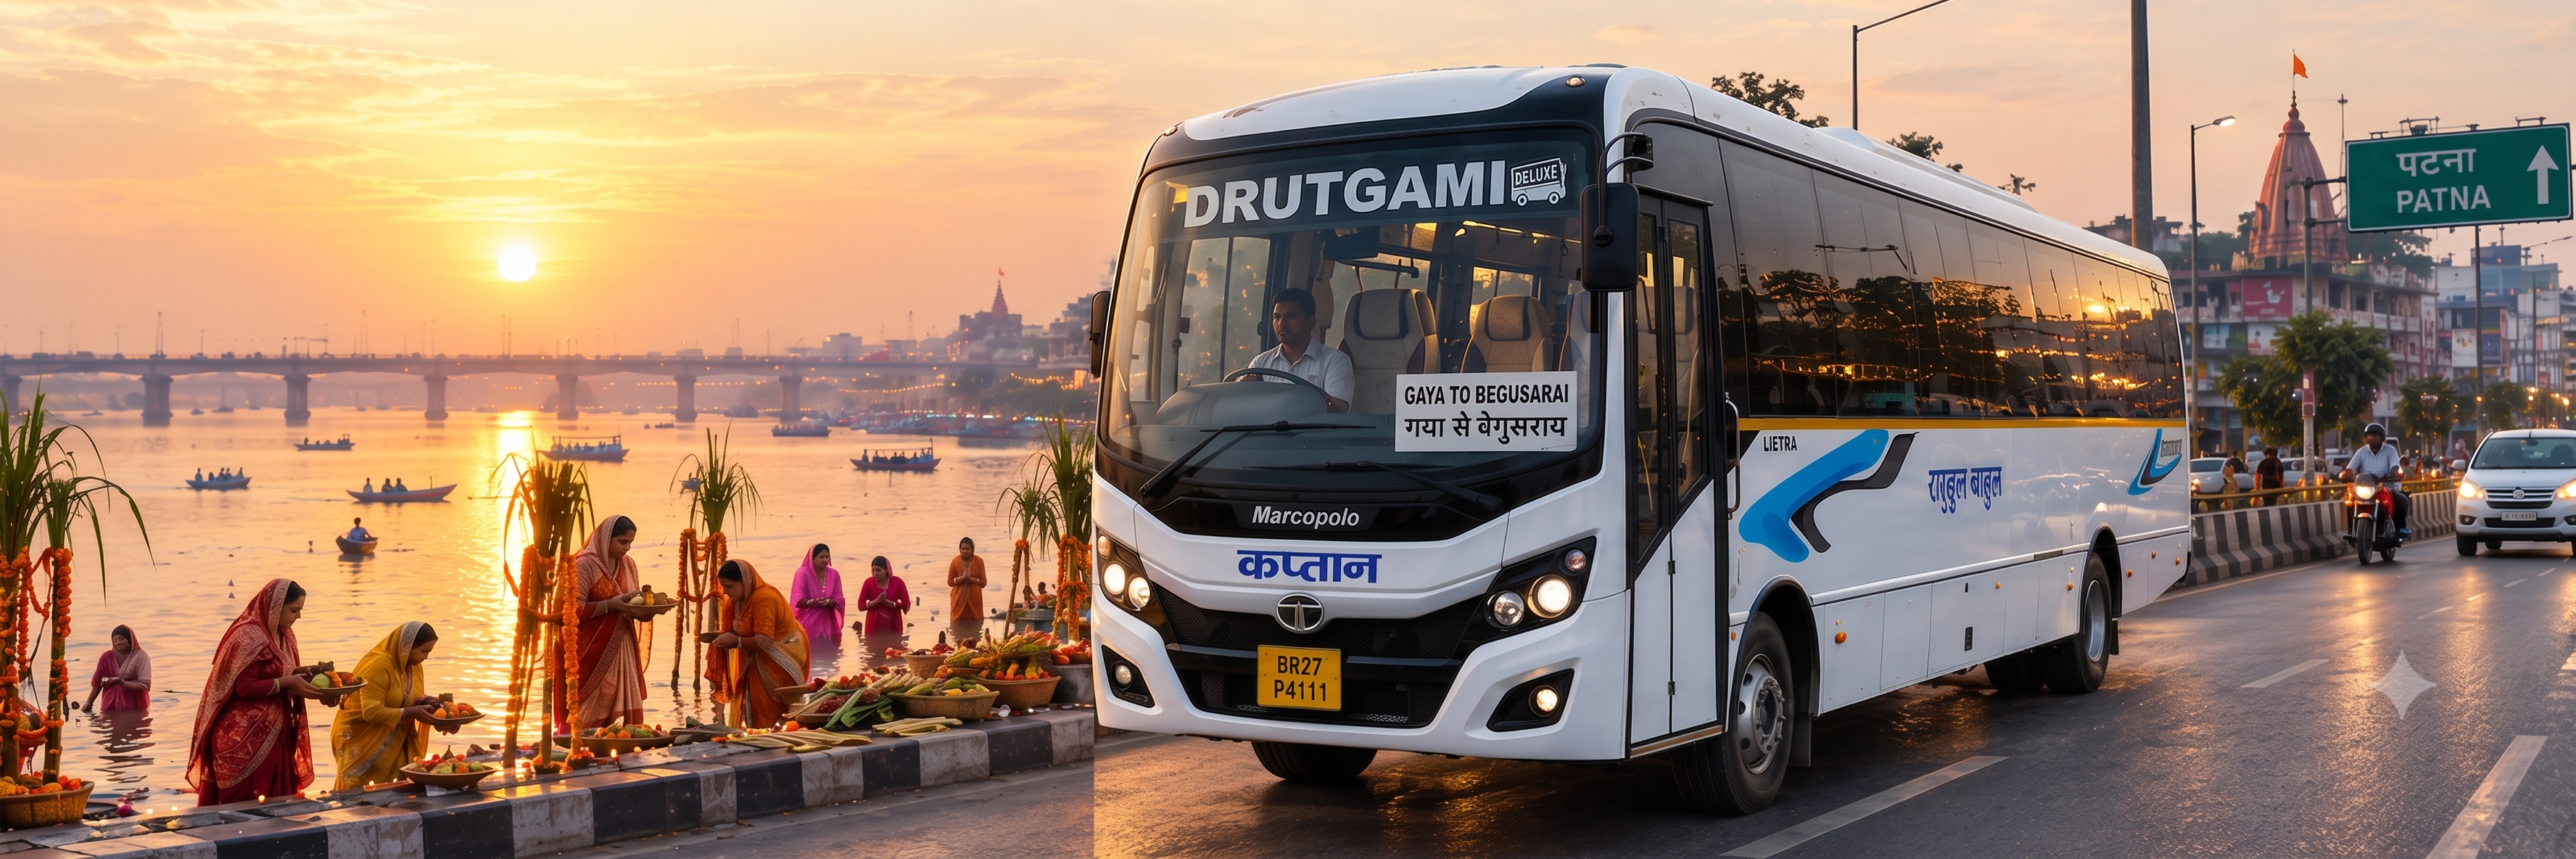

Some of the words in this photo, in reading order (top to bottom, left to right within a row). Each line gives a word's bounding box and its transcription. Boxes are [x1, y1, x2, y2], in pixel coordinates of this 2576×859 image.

[2395, 148, 2477, 177] पटना
[1515, 164, 1558, 186] DELUXE
[1184, 160, 1506, 228] DRUTGAMI
[2397, 185, 2492, 213] PATNA
[1404, 385, 1446, 405] GAYA
[1450, 385, 1471, 404] TO
[1475, 384, 1569, 404] BEGUSARAI
[1404, 418, 1446, 437] गया
[1451, 411, 1472, 437] से
[1763, 435, 1798, 452] LIETRA
[1252, 506, 1360, 529] Marcopolo
[1237, 549, 1382, 583] कप्तान
[1277, 655, 1323, 676] BR27
[1274, 679, 1326, 702] P4111
